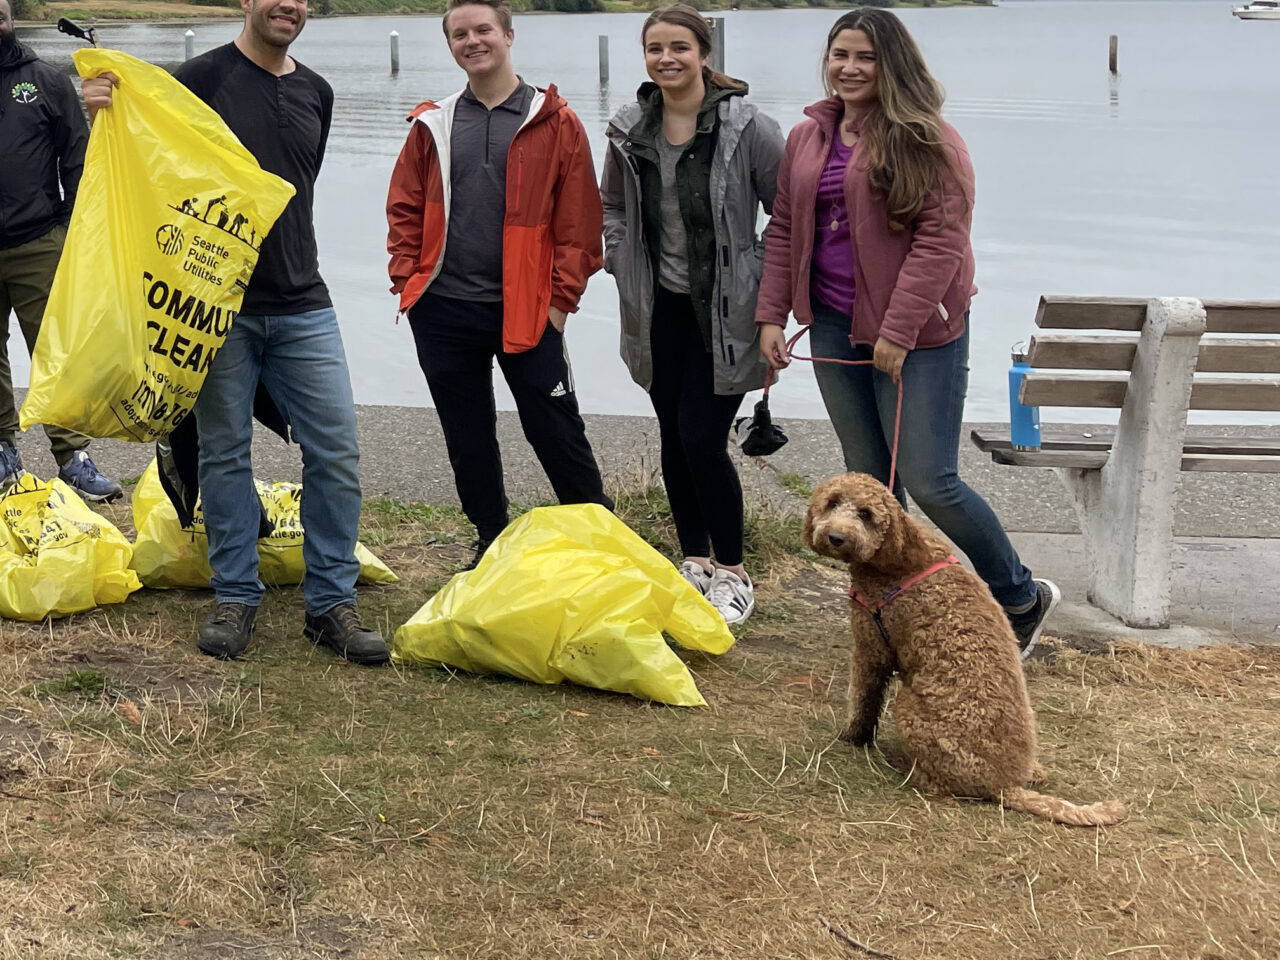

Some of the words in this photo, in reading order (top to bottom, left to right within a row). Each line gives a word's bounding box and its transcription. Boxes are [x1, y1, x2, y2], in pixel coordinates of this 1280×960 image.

[187, 248, 219, 270] Public
[192, 234, 229, 260] Seattle
[183, 260, 222, 286] Utilities
